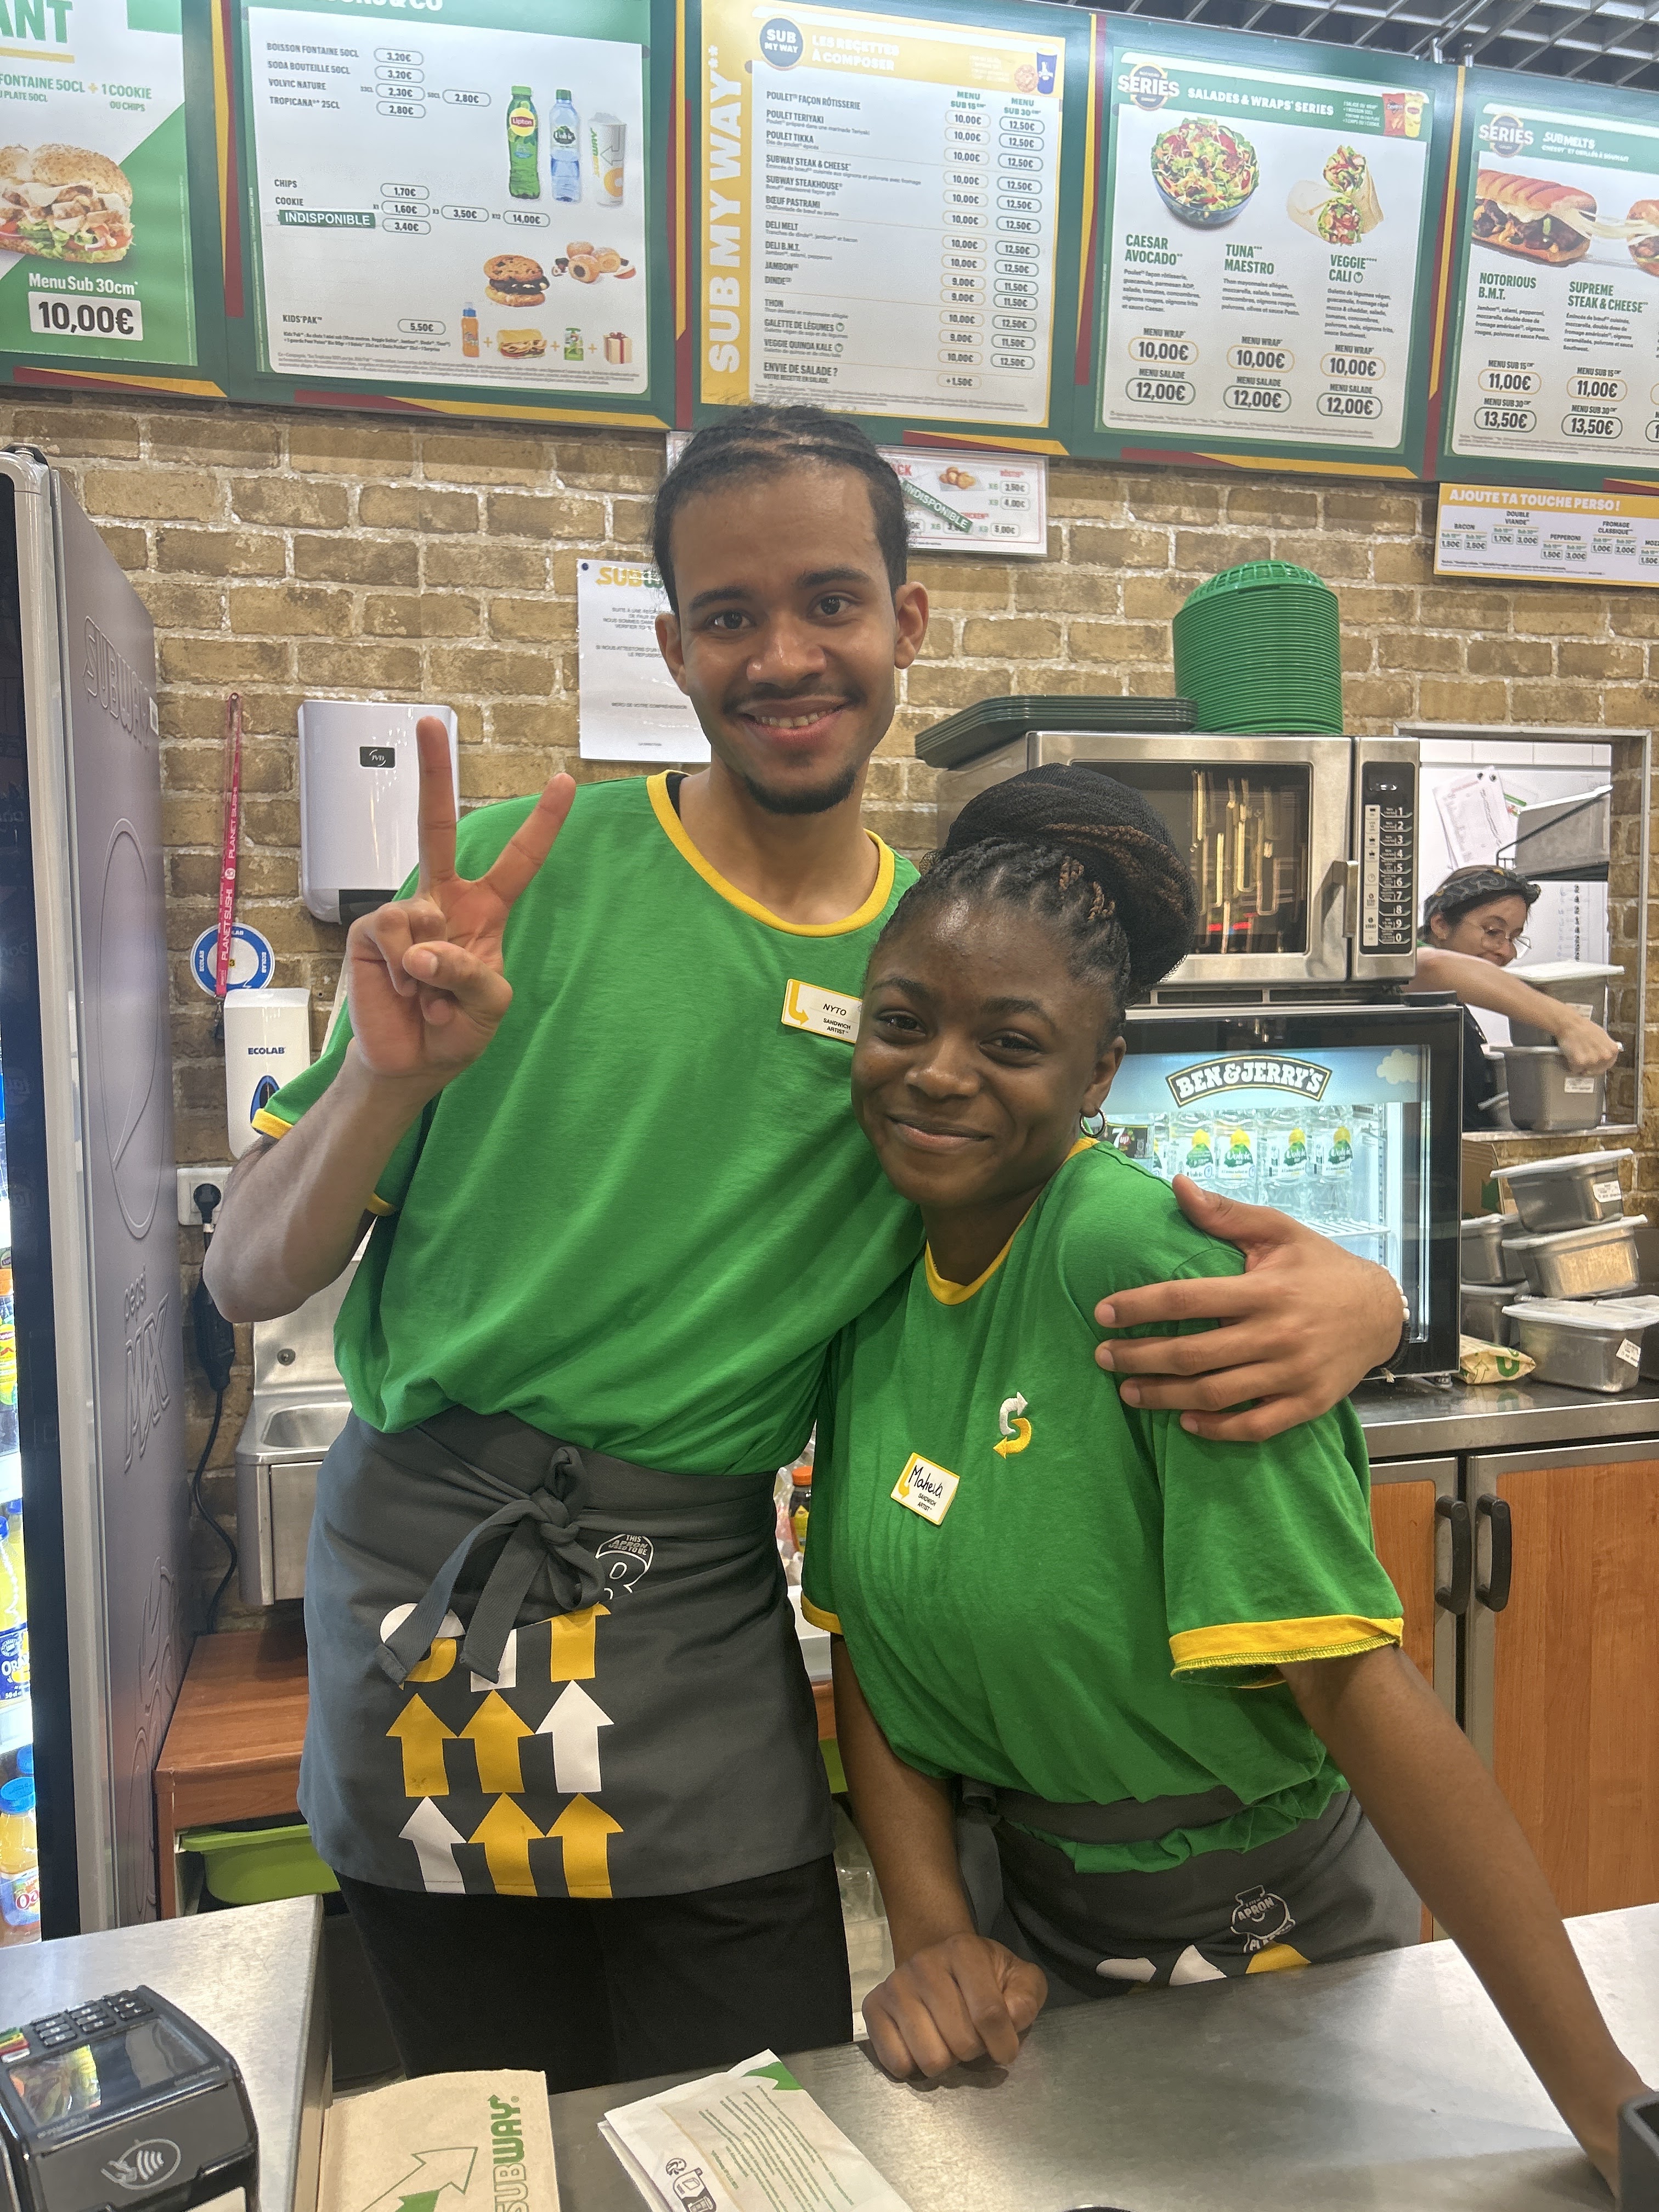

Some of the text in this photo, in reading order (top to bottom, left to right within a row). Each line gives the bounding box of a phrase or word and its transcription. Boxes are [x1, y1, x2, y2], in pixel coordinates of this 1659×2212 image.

[767, 29, 796, 43] SUB
[812, 35, 834, 47] LES
[267, 43, 359, 58] BOISSON FONTAINE 50CL
[764, 42, 799, 53] MY WAY
[267, 61, 351, 74] SODA BOUTEILLE 50CL
[823, 52, 895, 71] COMPOSER
[56, 79, 85, 93] 50CL
[109, 85, 152, 99] COOKIE
[297, 81, 326, 90] NATURE
[1117, 74, 1180, 98] SERIES
[4, 91, 26, 100] PLATE
[799, 95, 861, 110] FAÇON RÔTISSERIE
[957, 91, 980, 100] MENU
[1011, 98, 1035, 106] MENU
[1188, 88, 1240, 104] SALADES
[1240, 94, 1249, 105] &
[1295, 101, 1334, 116] SERIES
[321, 100, 340, 109] 25CL
[512, 117, 533, 127] Lipton
[766, 110, 824, 123] POULET TERIYAKI
[766, 131, 814, 143] POULET TIKKA
[1479, 124, 1534, 145] SERIES
[766, 155, 794, 165] SUBWAY
[795, 158, 817, 167] STEAK
[274, 179, 297, 188] CHIPS
[766, 176, 794, 185] SUBWAY
[275, 197, 304, 206] COOKIE
[787, 198, 820, 208] PASTRAMI
[285, 212, 370, 225] INDISPONIBLE
[765, 221, 798, 230] DELI MELT
[709, 189, 741, 268] MY
[1126, 234, 1169, 250] CAESAR
[1224, 259, 1275, 275] MAESTRO
[29, 273, 66, 289] Menu
[67, 276, 94, 292] Sub
[1329, 269, 1352, 283] CALI
[1480, 273, 1536, 289] NOTORIOUS
[1479, 286, 1506, 300] B.M.T.
[1569, 280, 1614, 296] SUPREME
[1568, 295, 1606, 309] STEAK &
[38, 302, 133, 335] 10,00€
[709, 276, 740, 373] SUB
[1143, 328, 1164, 337] MENU
[1139, 341, 1189, 361] 10,00€
[1237, 350, 1285, 369] 10,00€
[1139, 368, 1185, 379] MENU SALADE
[1330, 358, 1376, 376] 10,00€
[1489, 373, 1531, 391] 11,00€
[1577, 379, 1618, 398] 11,00€
[1137, 382, 1186, 400] 12,00€
[1234, 390, 1282, 408] 12,00€
[1327, 397, 1374, 415] 12,00€
[1484, 411, 1527, 428] 13,50€
[1572, 417, 1613, 435] 13,50€
[904, 481, 968, 530] INDISPONIBLE
[1449, 489, 1620, 511] AJOUTE TA TOUCHE PERSO !
[1398, 807, 1403, 816] 1
[1397, 821, 1403, 830] 2
[1397, 835, 1403, 844] 3
[1397, 849, 1403, 858] 4
[1397, 864, 1403, 872] 5
[1396, 877, 1402, 886] 6
[1396, 891, 1402, 900] 7
[1396, 905, 1402, 914] 8
[1396, 919, 1402, 928] 9
[222, 923, 230, 961] PLANET
[1395, 933, 1401, 942] 0
[823, 1003, 847, 1015] NYTO
[823, 1018, 851, 1030] SANDWICH
[1175, 1065, 1222, 1098] BEN
[1241, 1062, 1323, 1093] JERRY'S
[123, 1262, 146, 1334] pepsi
[123, 1293, 171, 1475] MAX
[612, 1539, 648, 1549] APRON
[1238, 1897, 1274, 1921] APRON
